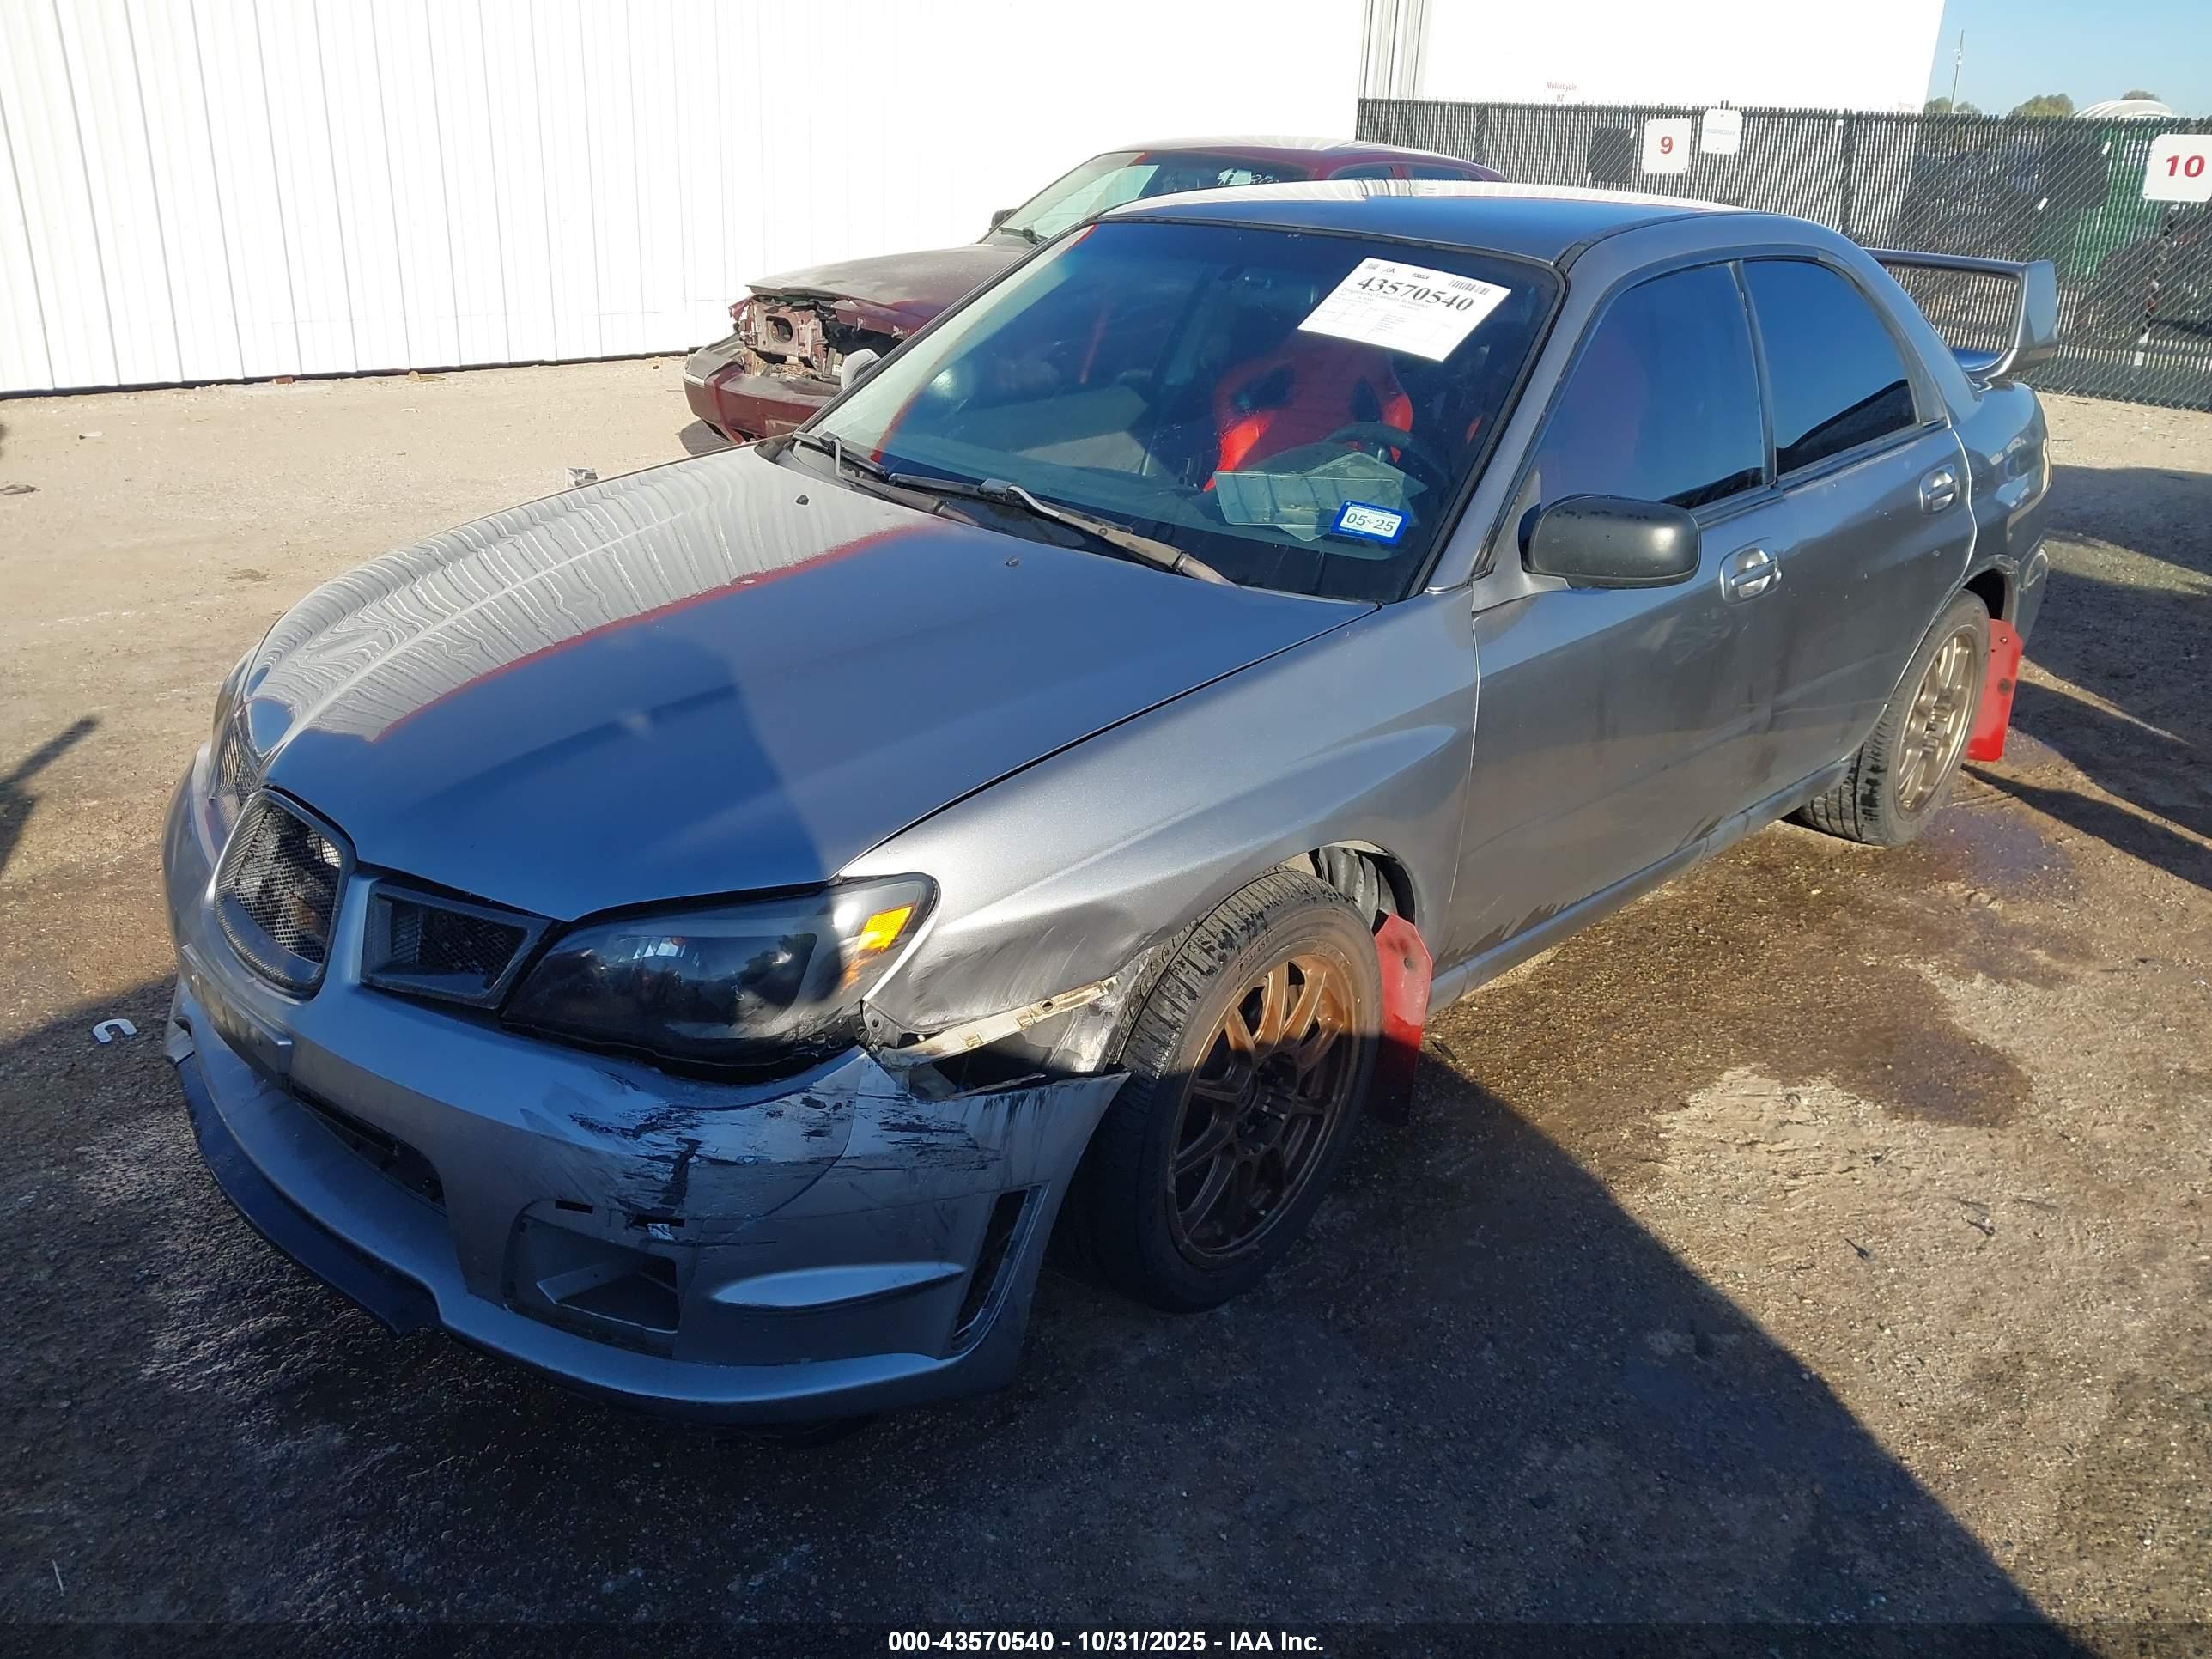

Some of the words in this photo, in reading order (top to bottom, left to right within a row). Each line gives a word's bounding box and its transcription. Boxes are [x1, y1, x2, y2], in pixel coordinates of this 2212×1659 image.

[1660, 136, 1674, 155] 9
[2166, 155, 2205, 178] 10
[1357, 276, 1474, 312] 43570540
[1346, 513, 1368, 526] 05
[1373, 519, 1395, 532] 25
